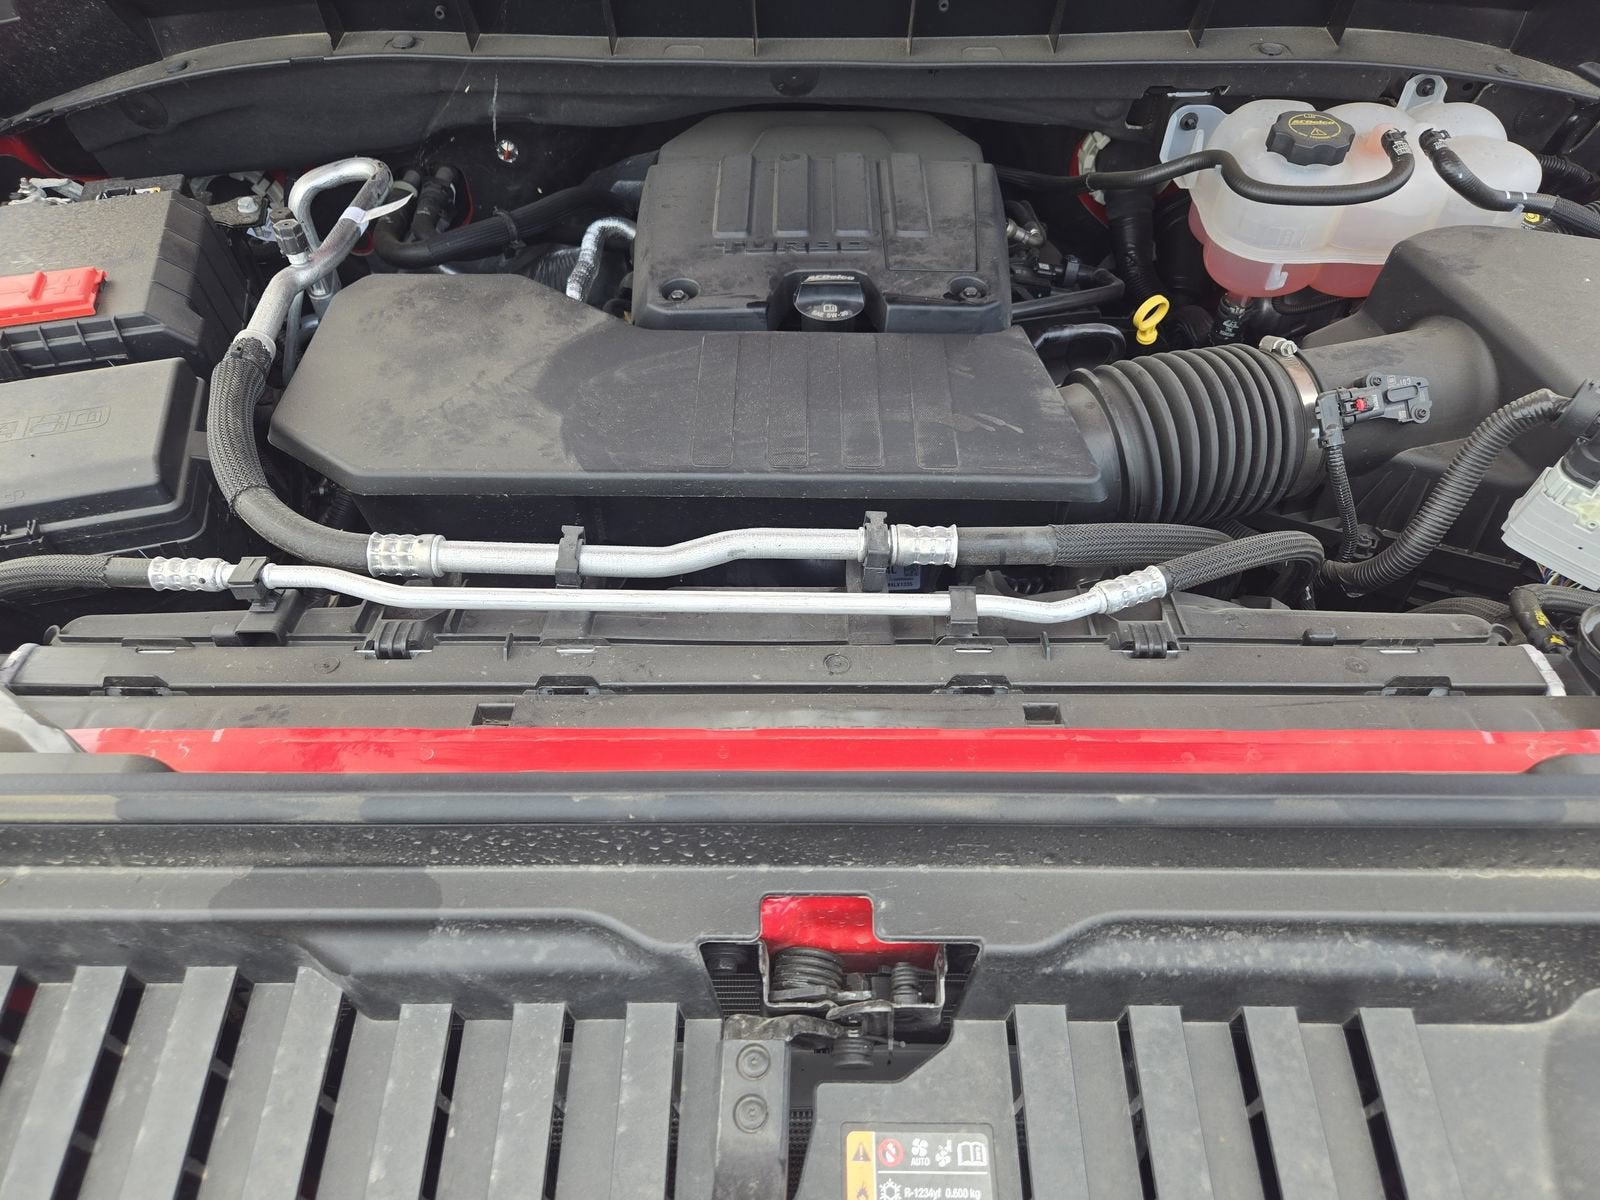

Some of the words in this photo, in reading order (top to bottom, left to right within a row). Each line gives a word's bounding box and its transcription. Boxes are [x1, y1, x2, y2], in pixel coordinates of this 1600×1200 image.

[714, 239, 870, 254] TURBO
[910, 1156, 931, 1167] AUTO
[903, 1187, 942, 1200] R-1234yf
